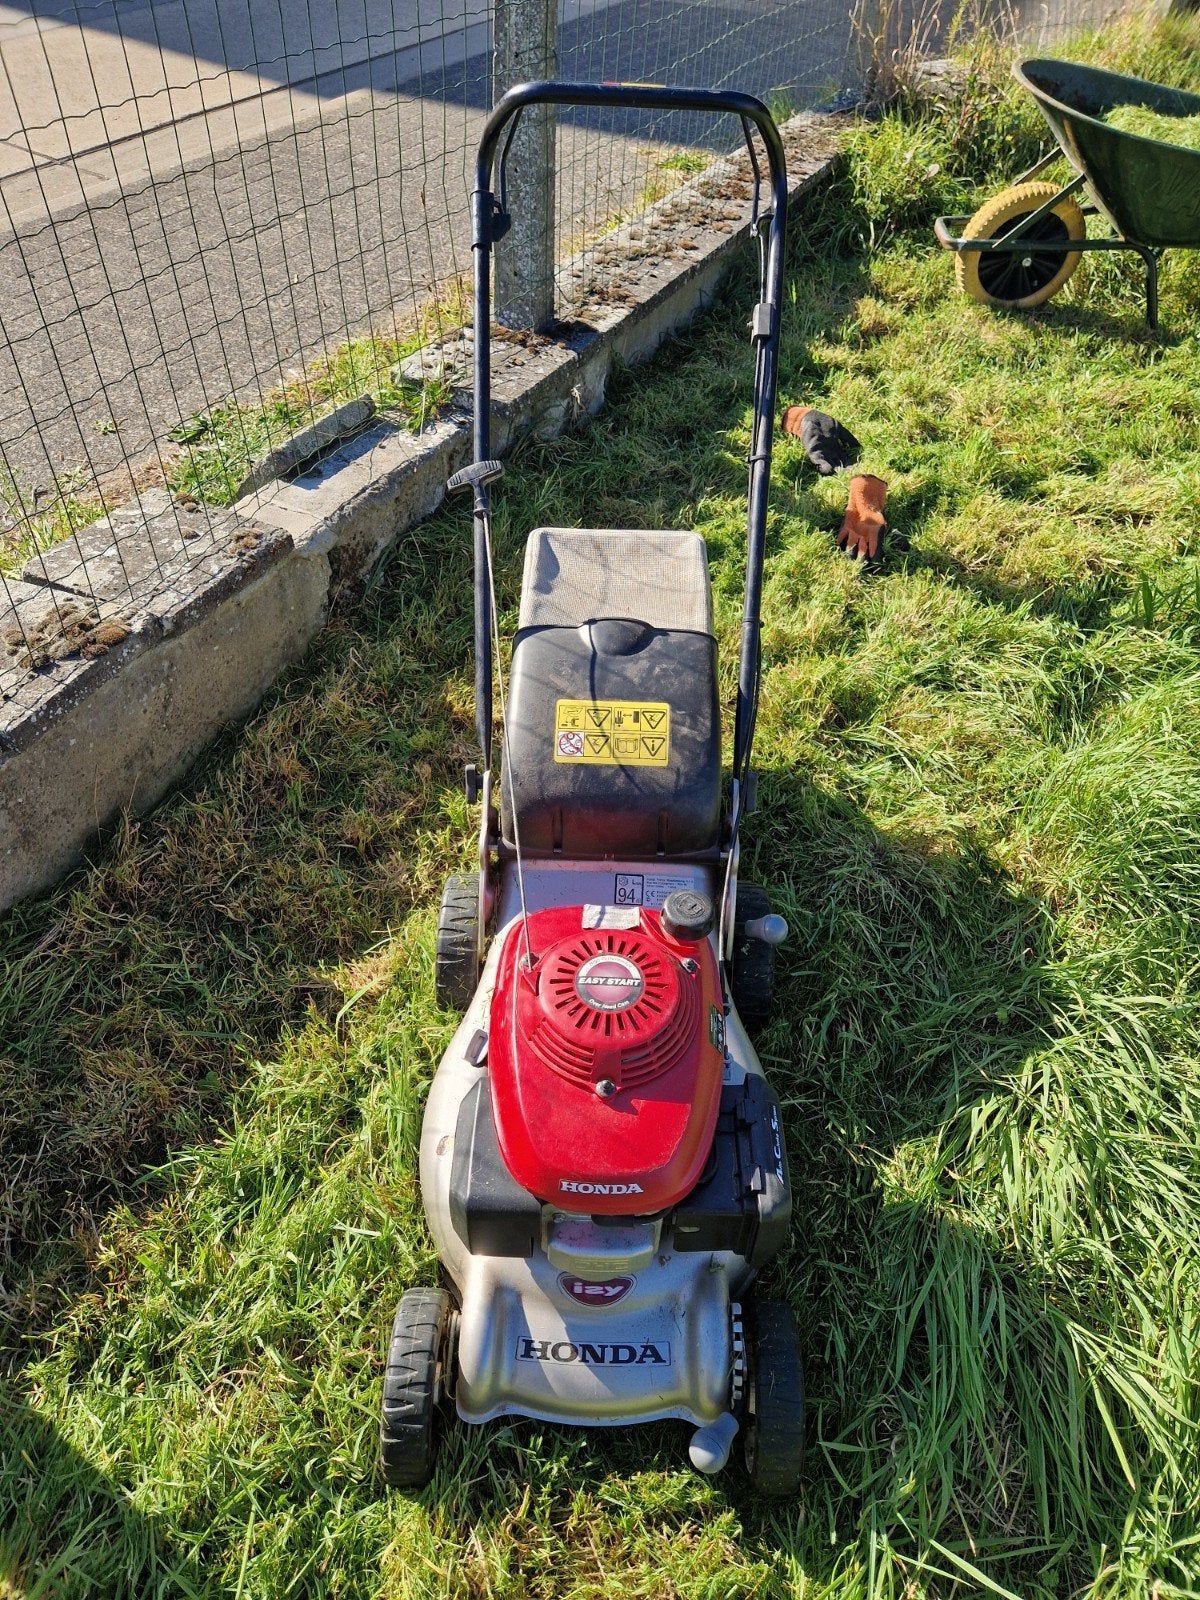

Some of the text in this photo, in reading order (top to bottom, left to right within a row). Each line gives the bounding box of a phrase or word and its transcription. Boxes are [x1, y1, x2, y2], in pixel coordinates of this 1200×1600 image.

[618, 887, 636, 903] 94
[578, 977, 641, 987] EASY START
[560, 1181, 644, 1195] HONDA
[573, 1282, 625, 1297] izy
[520, 1338, 667, 1364] HONDA
